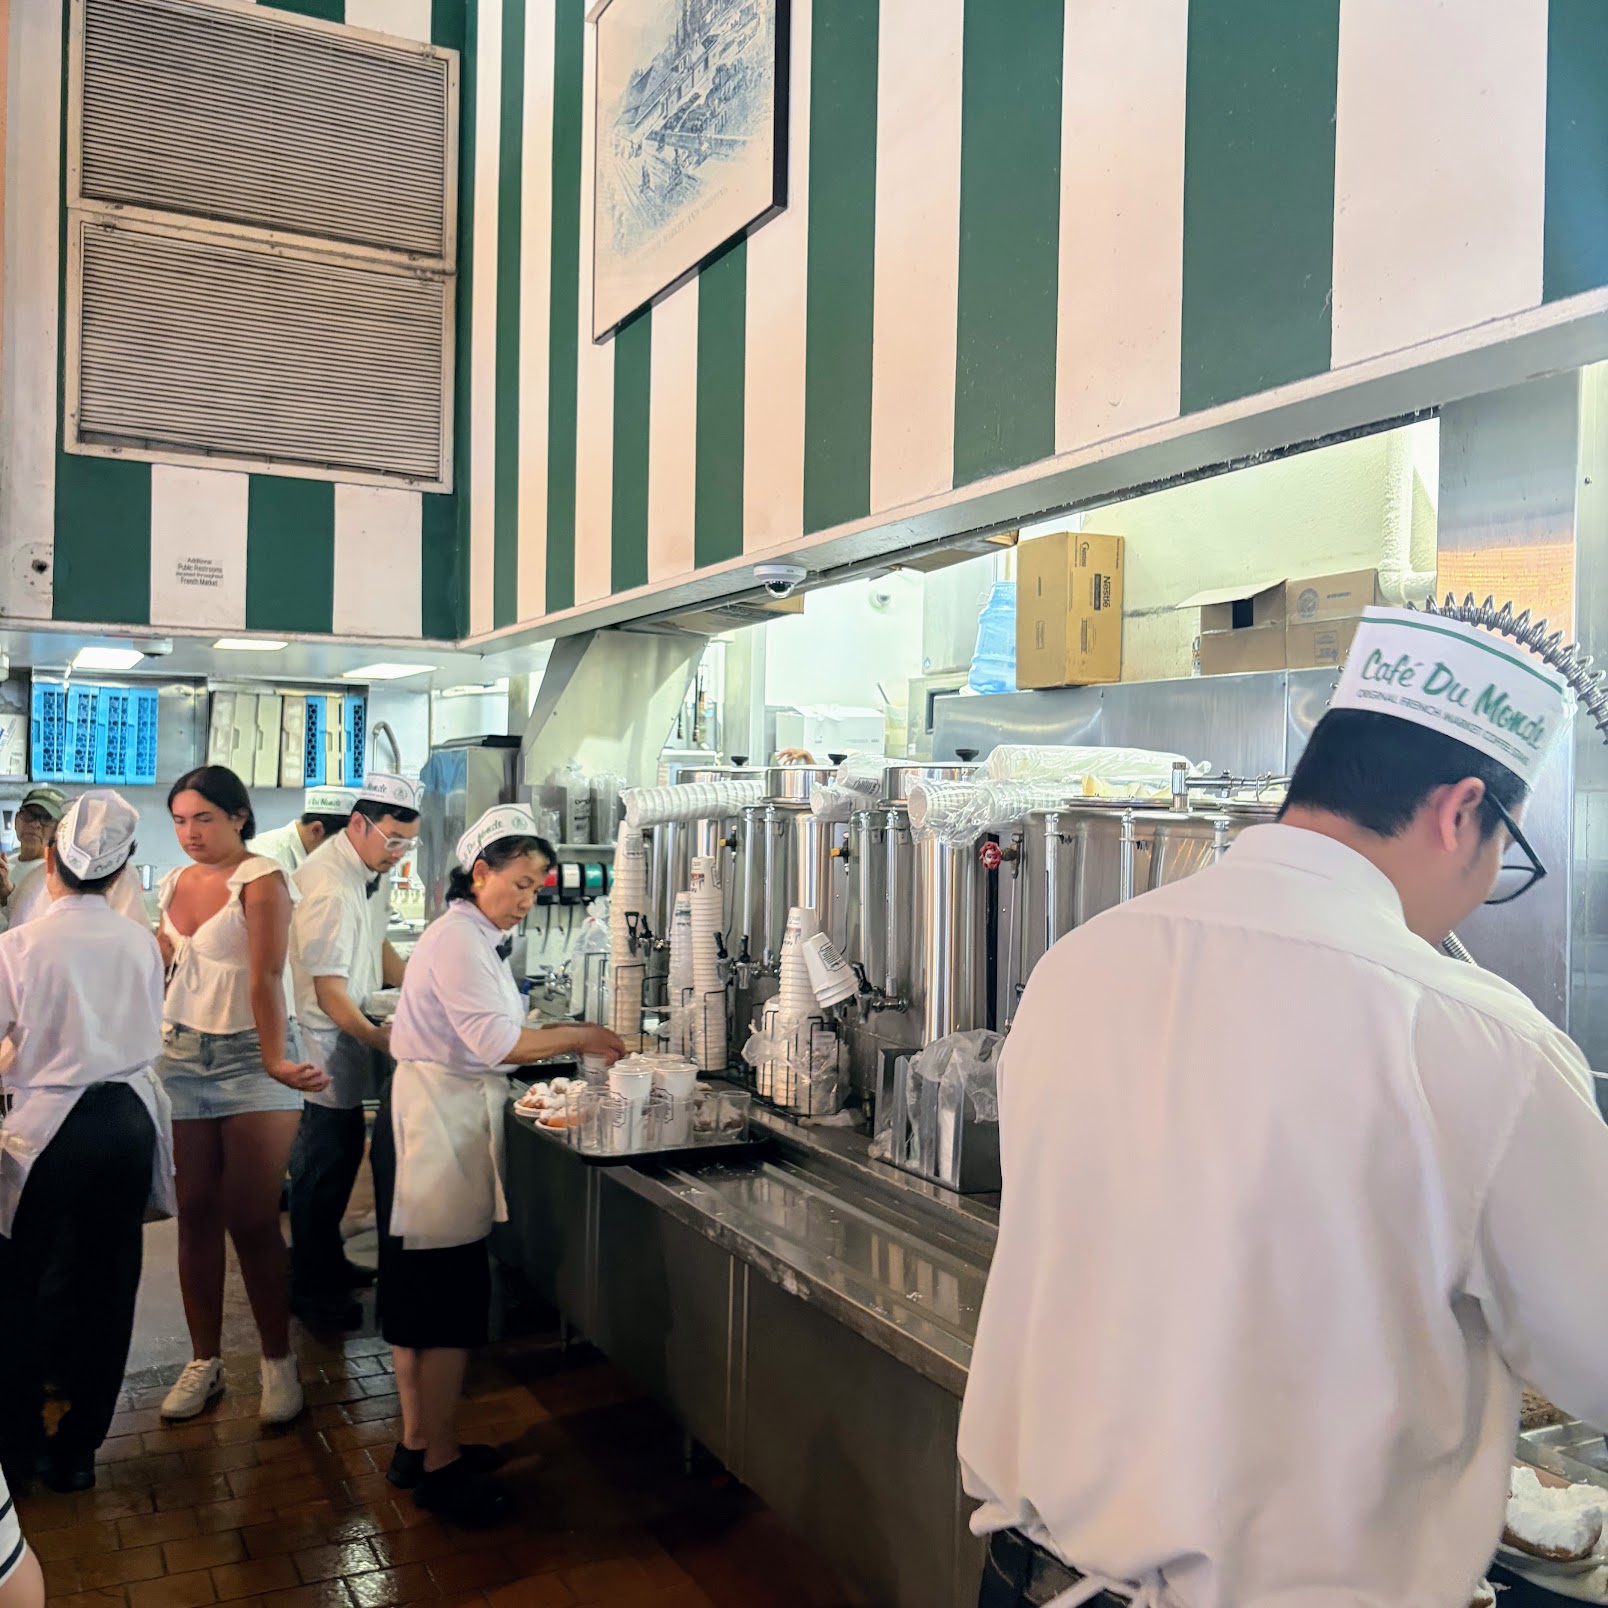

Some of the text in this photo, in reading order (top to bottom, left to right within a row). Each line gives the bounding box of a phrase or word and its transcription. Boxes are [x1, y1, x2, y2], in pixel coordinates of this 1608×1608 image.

[177, 563, 222, 573] Public Restrooms
[180, 576, 218, 587] French Market
[1361, 648, 1425, 688] Café
[1422, 661, 1472, 709] Du
